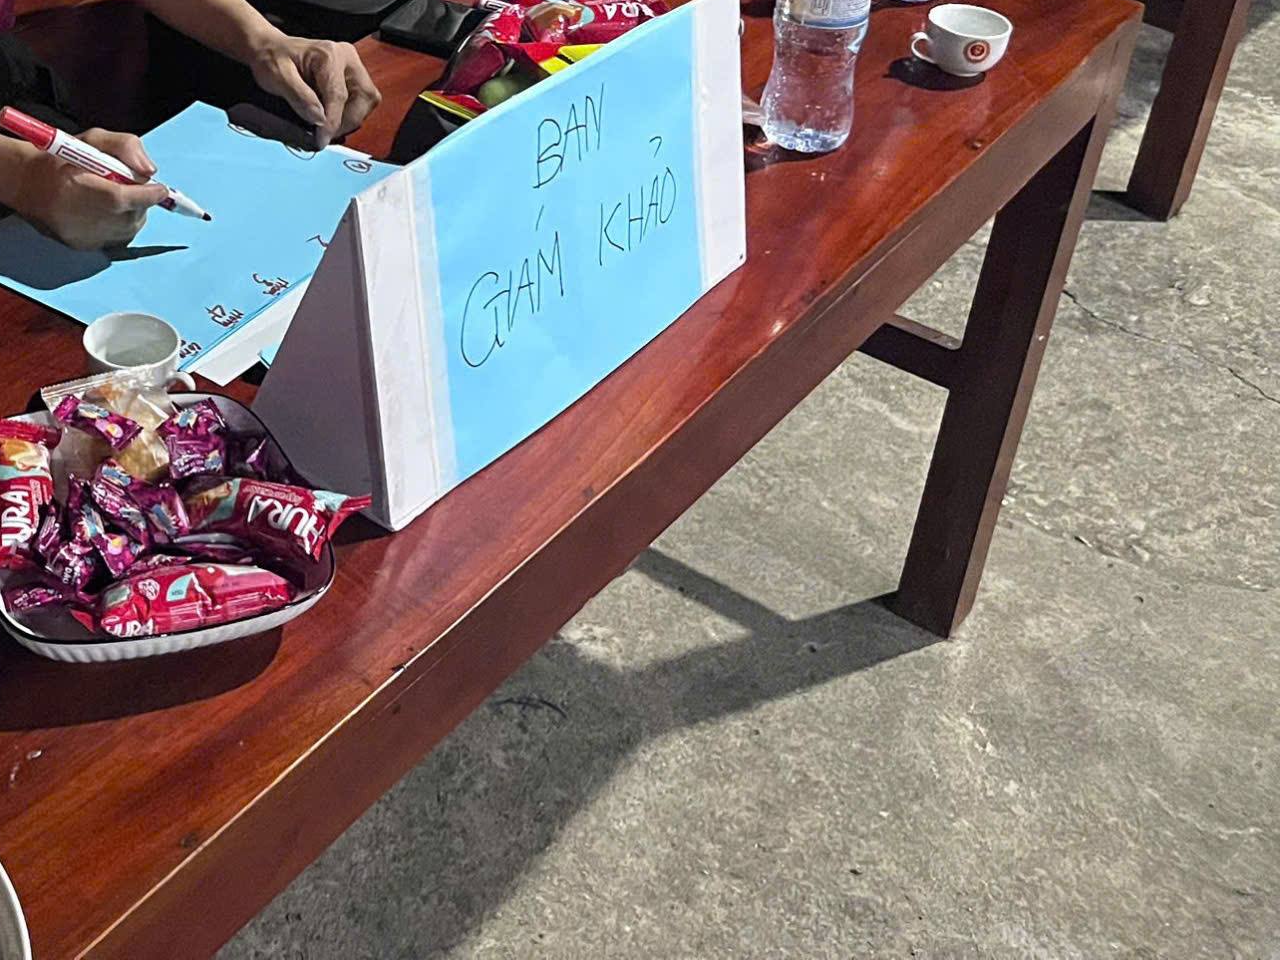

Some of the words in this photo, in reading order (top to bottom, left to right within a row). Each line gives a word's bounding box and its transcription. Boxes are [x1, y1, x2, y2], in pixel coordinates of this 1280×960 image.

[533, 83, 604, 189] BAN
[461, 204, 563, 367] GIÁM
[598, 136, 677, 266] KHẢO
[246, 495, 326, 555] HURA
